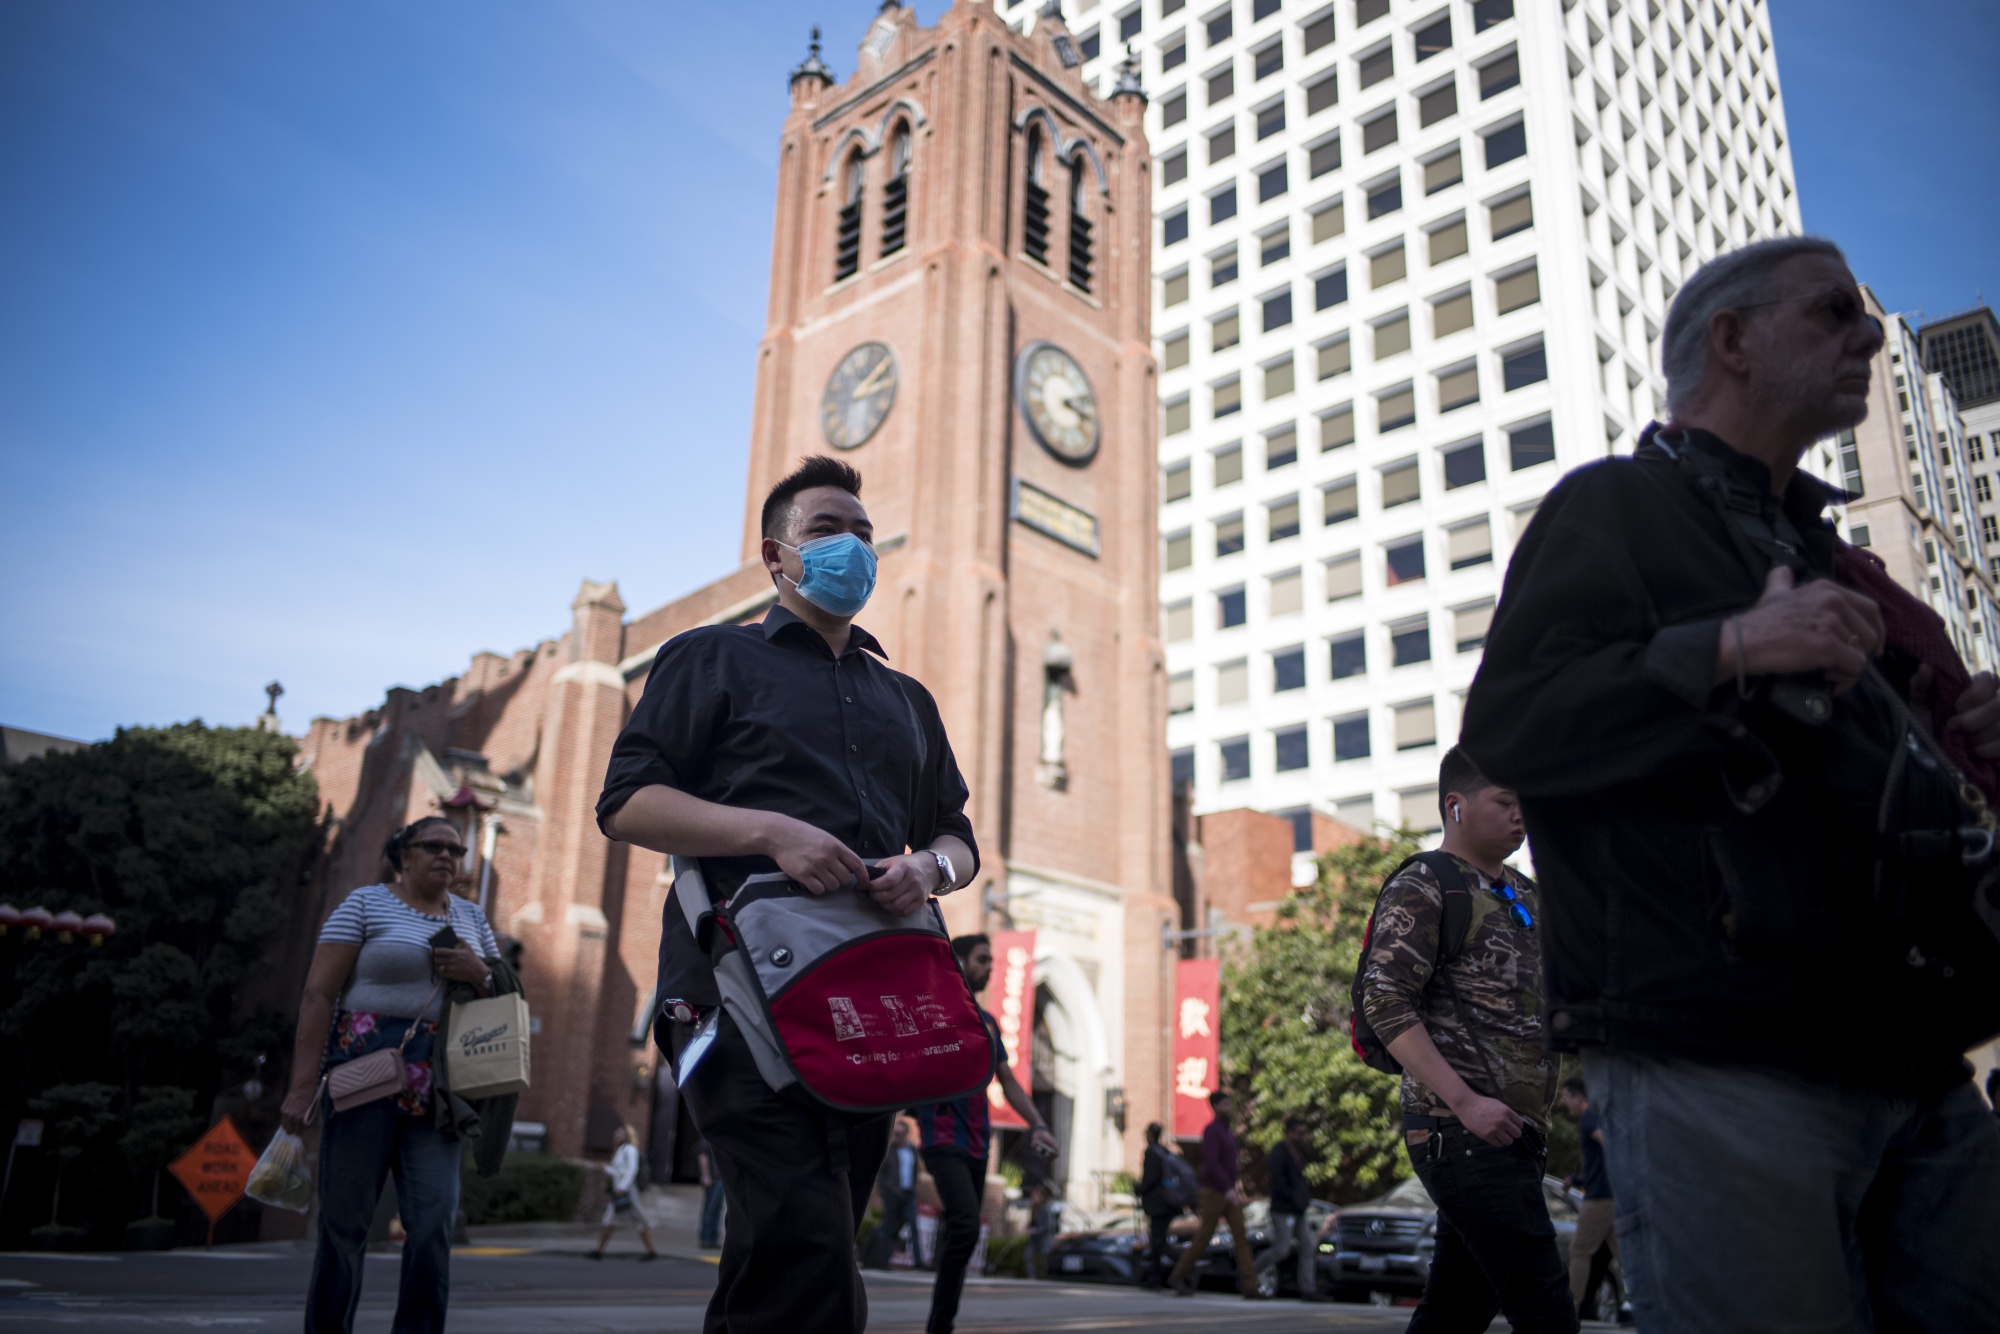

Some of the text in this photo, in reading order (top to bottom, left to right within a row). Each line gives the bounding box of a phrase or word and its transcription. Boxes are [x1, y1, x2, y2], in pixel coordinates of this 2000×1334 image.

[464, 1042, 507, 1057] MARKET
[887, 1050, 901, 1062] for
[204, 1140, 240, 1156] ROAD
[201, 1161, 237, 1175] WORK
[197, 1180, 239, 1194] AHEAD
